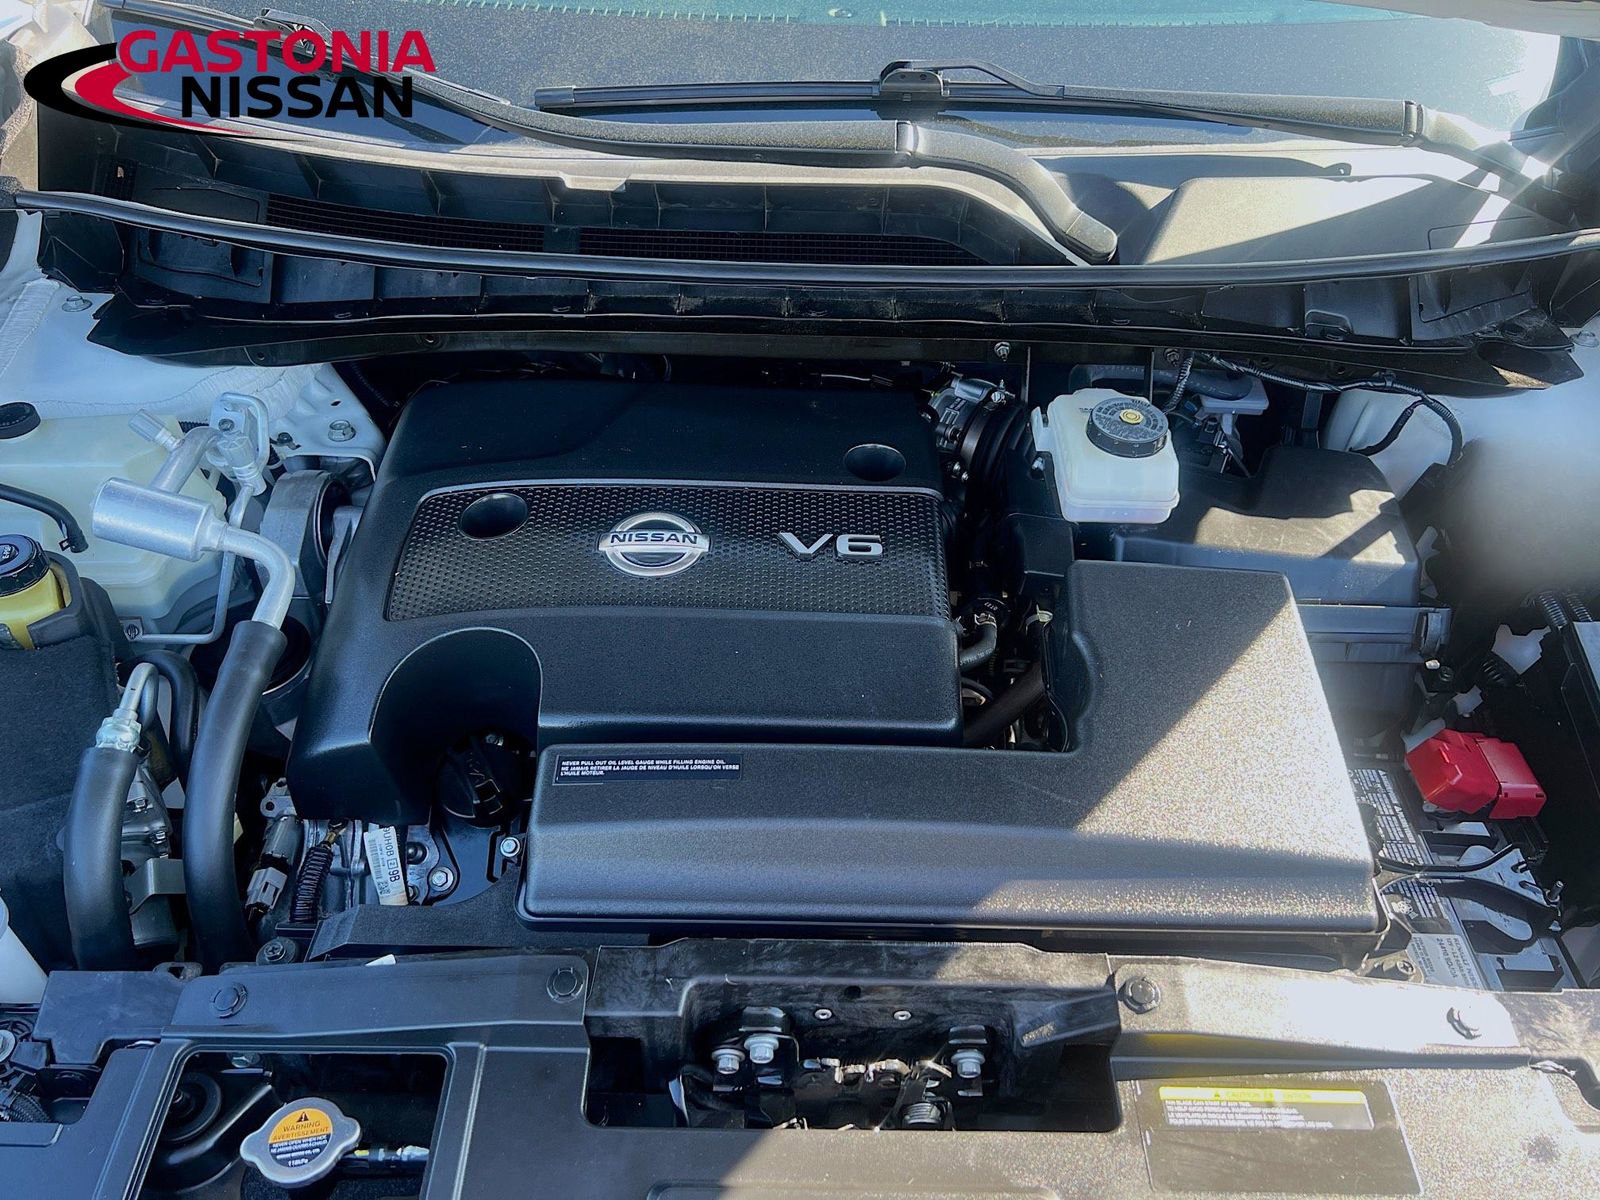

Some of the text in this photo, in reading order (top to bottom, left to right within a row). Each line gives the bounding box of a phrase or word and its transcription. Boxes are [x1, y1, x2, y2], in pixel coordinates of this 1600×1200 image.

[610, 532, 698, 545] NISSAN
[779, 532, 883, 561] V6
[389, 869, 400, 883] 9B
[283, 1120, 321, 1132] WARNING
[273, 1127, 329, 1141] AVERTISSEMENT
